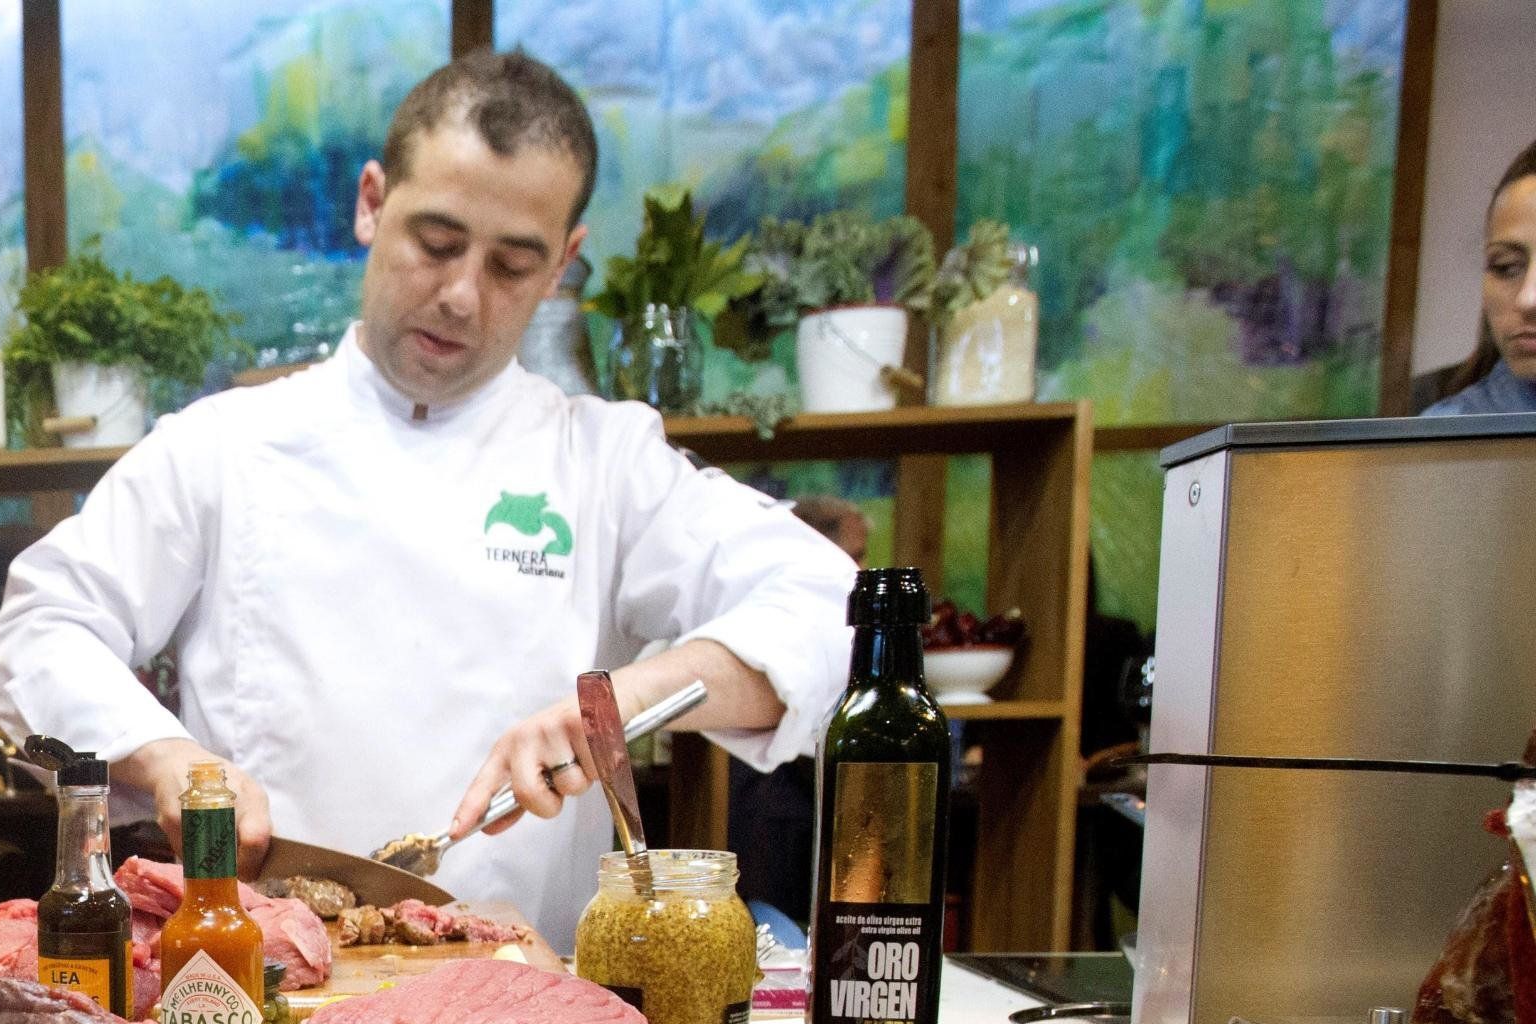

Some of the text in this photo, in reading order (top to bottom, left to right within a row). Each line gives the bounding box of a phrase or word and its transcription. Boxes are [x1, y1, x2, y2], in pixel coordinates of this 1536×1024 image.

[486, 547, 547, 566] TERNERA
[836, 914, 922, 927] aceite de oliva virgen extra
[861, 926, 877, 934] extra
[878, 926, 896, 935] virgin
[896, 926, 912, 935] olive
[867, 941, 920, 980] ORO
[51, 970, 80, 985] LEA
[830, 979, 918, 1019] VIRGEN
